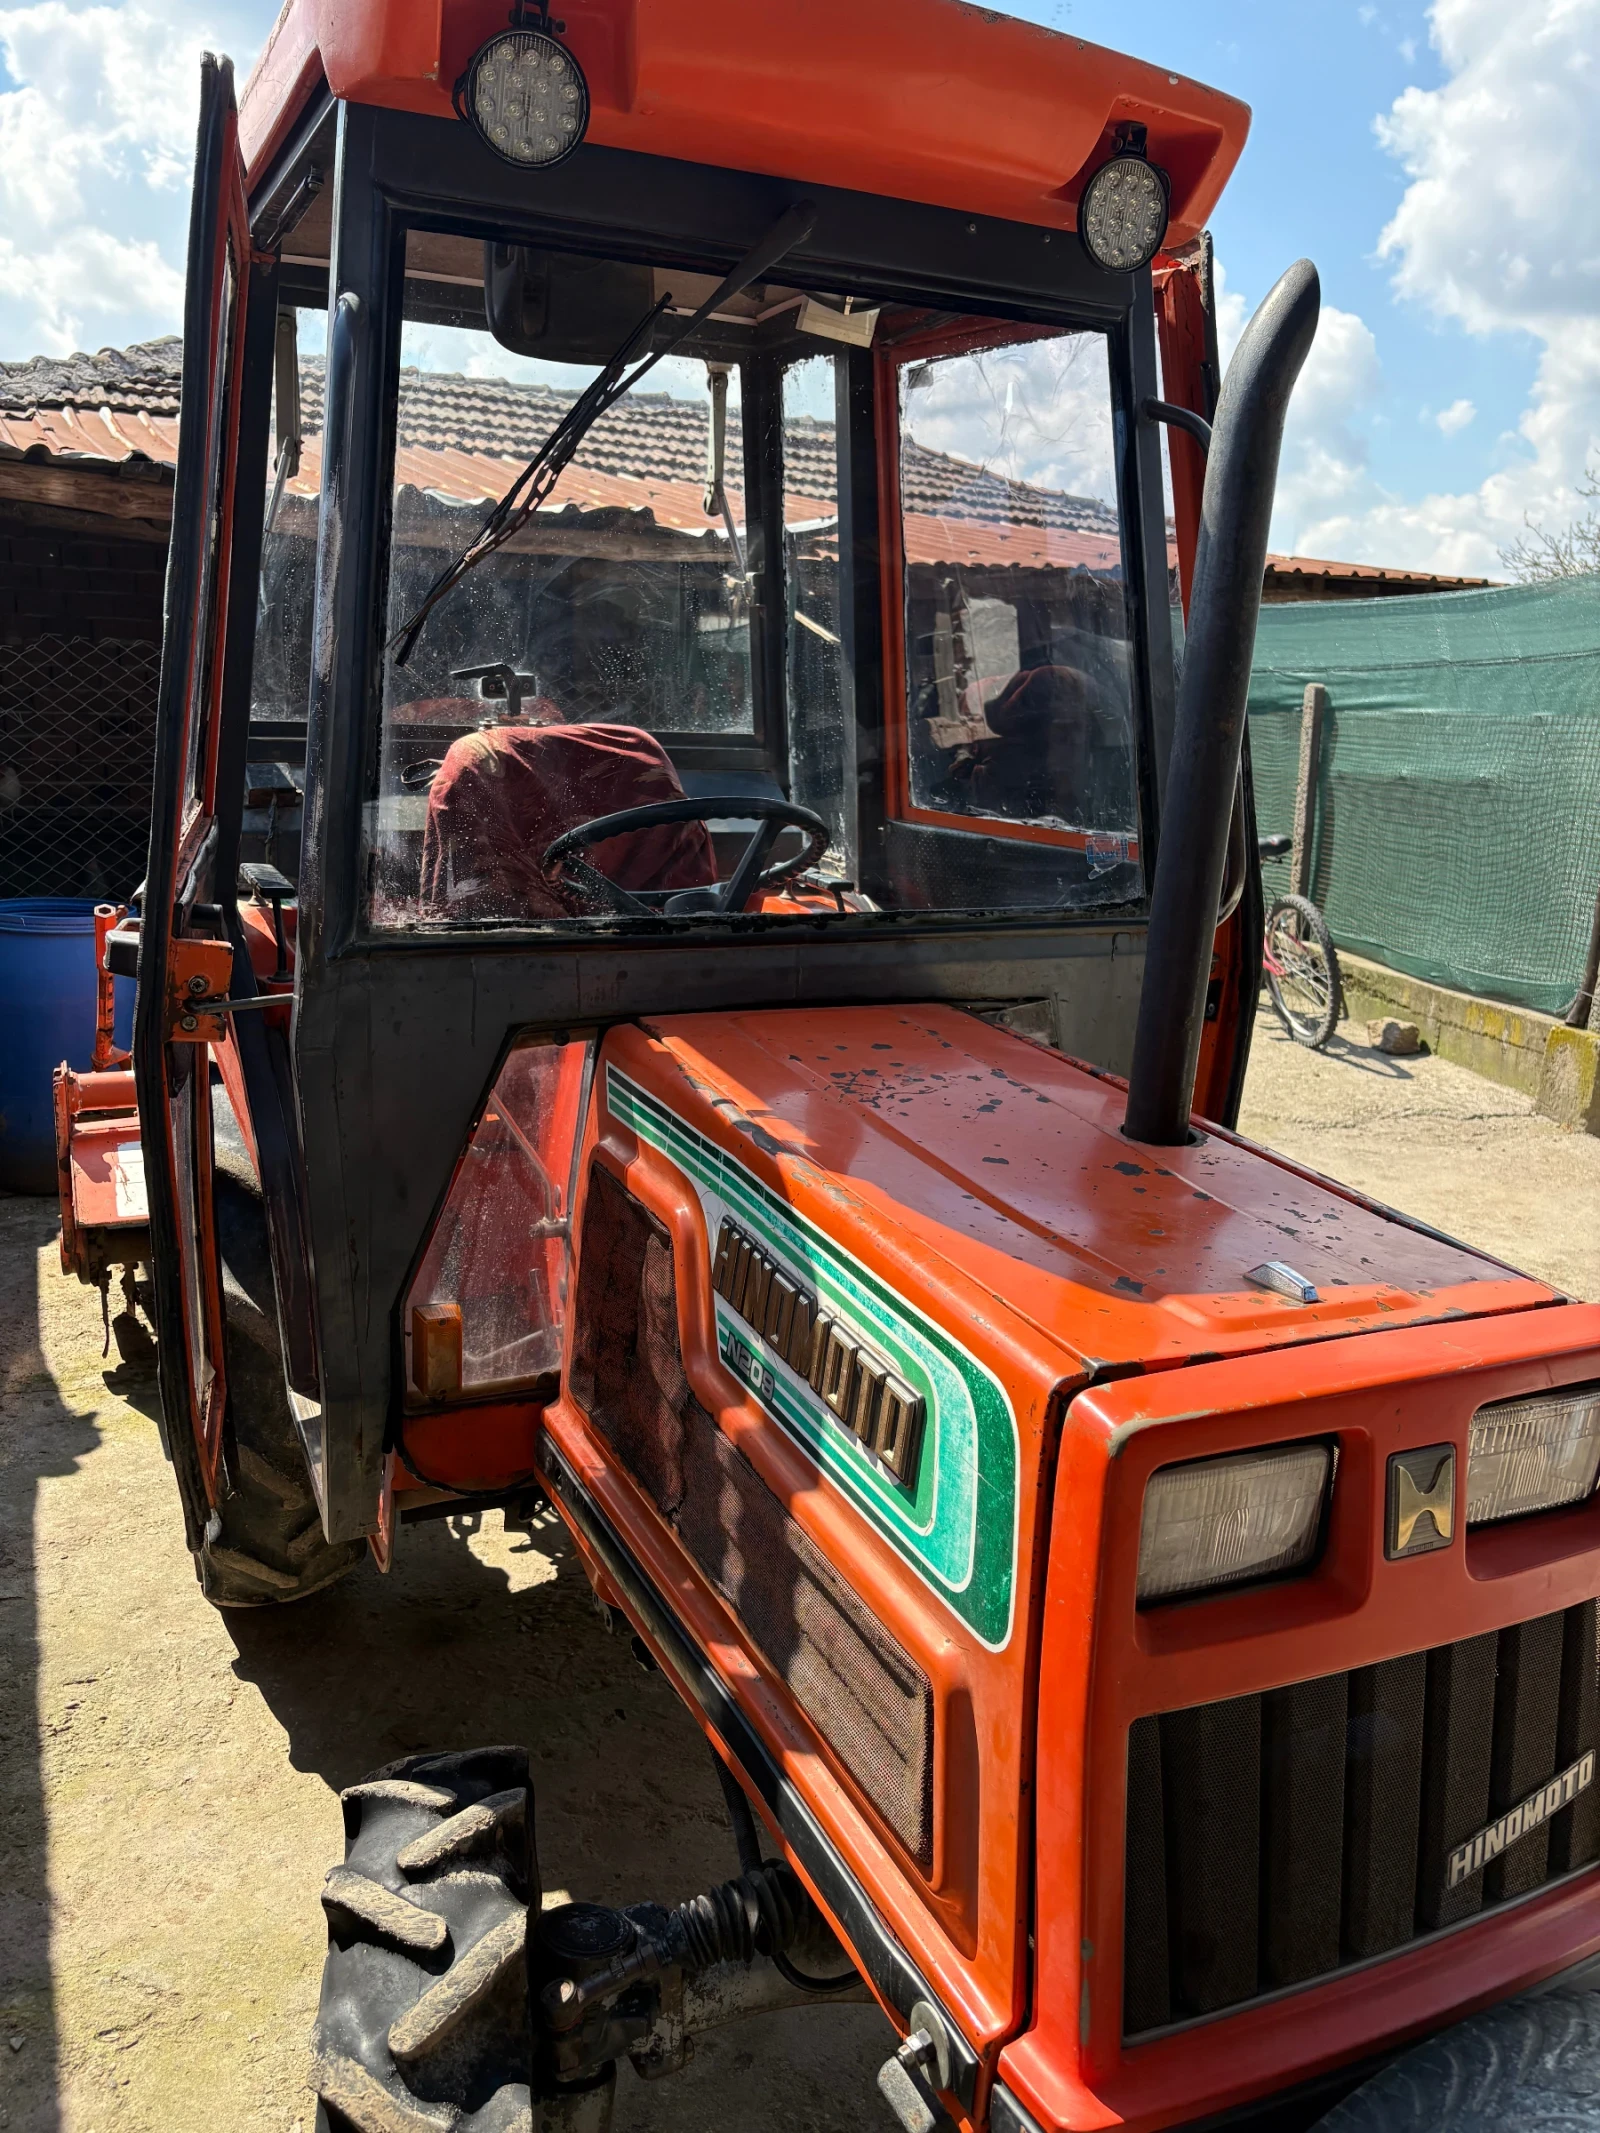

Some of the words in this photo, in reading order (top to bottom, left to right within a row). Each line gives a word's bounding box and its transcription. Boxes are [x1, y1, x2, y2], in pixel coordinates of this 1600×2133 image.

[712, 1214, 926, 1488] HINOMOTO
[726, 1331, 776, 1401] N209
[1450, 1752, 1594, 1888] HINOMOTO
